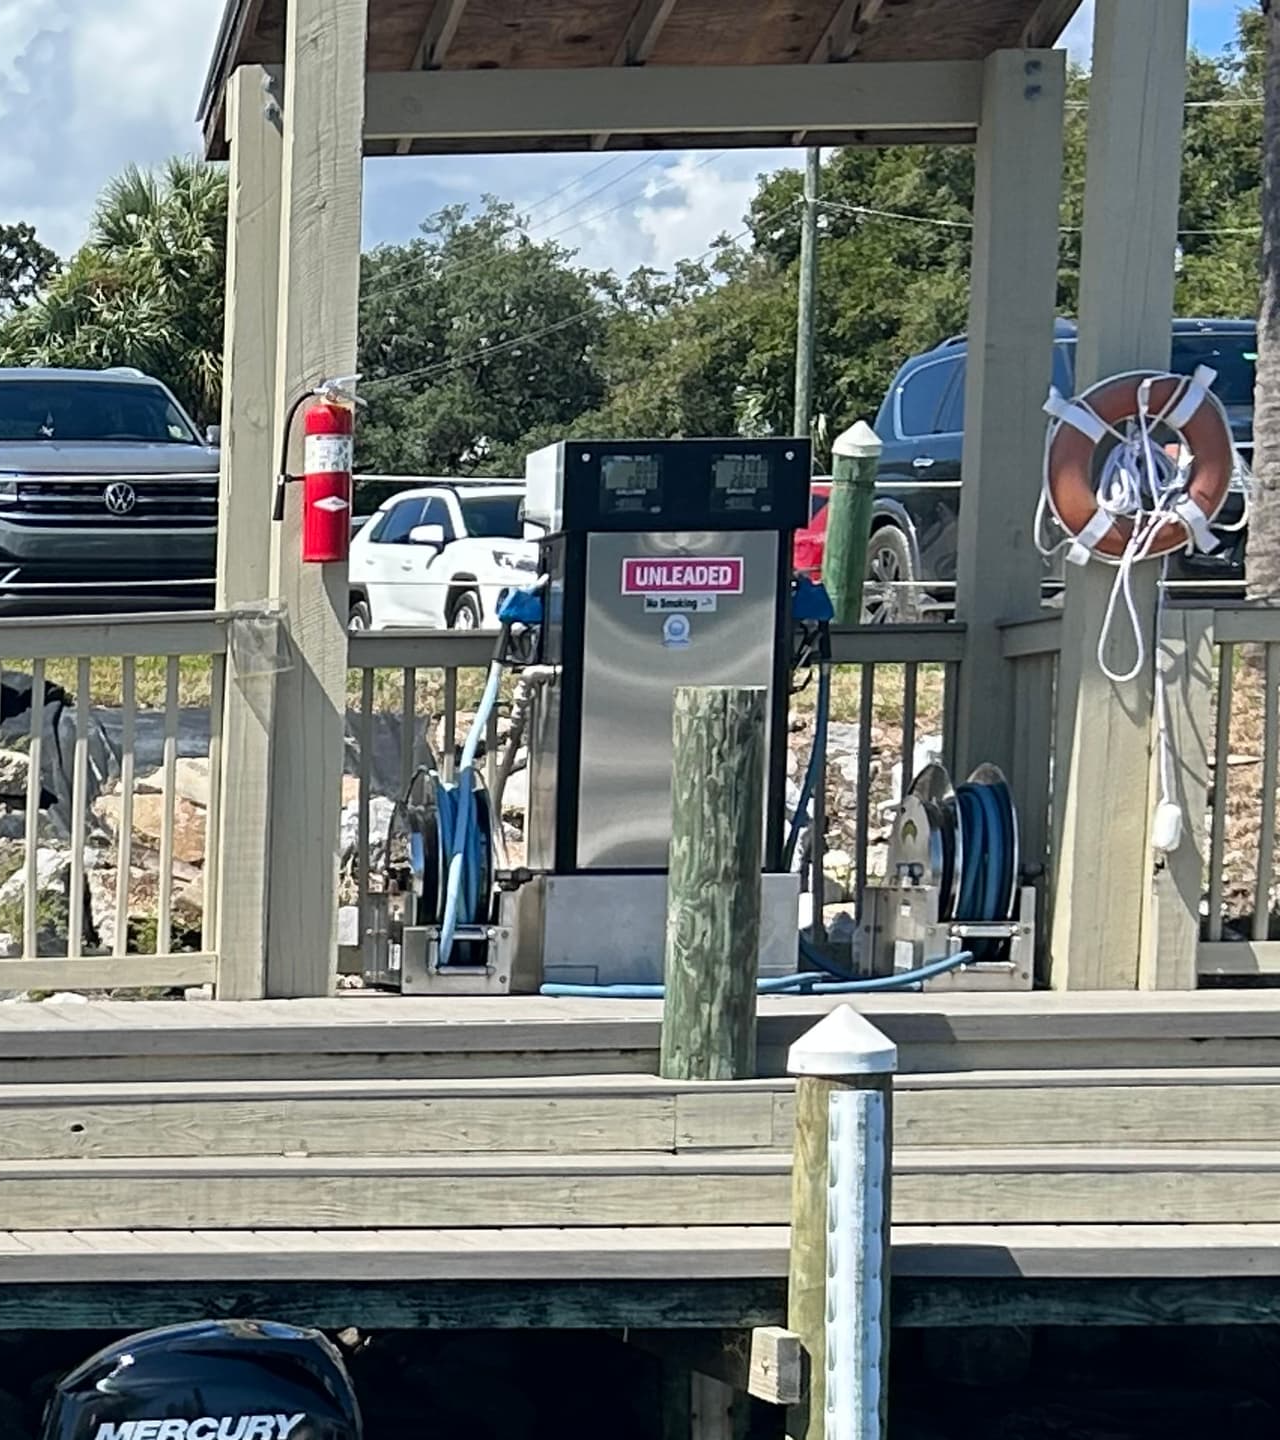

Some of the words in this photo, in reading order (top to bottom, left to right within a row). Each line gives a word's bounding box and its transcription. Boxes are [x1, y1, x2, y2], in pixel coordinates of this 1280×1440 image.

[635, 565, 733, 586] UNLEADED
[646, 598, 658, 608] No
[660, 598, 698, 610] Smoking
